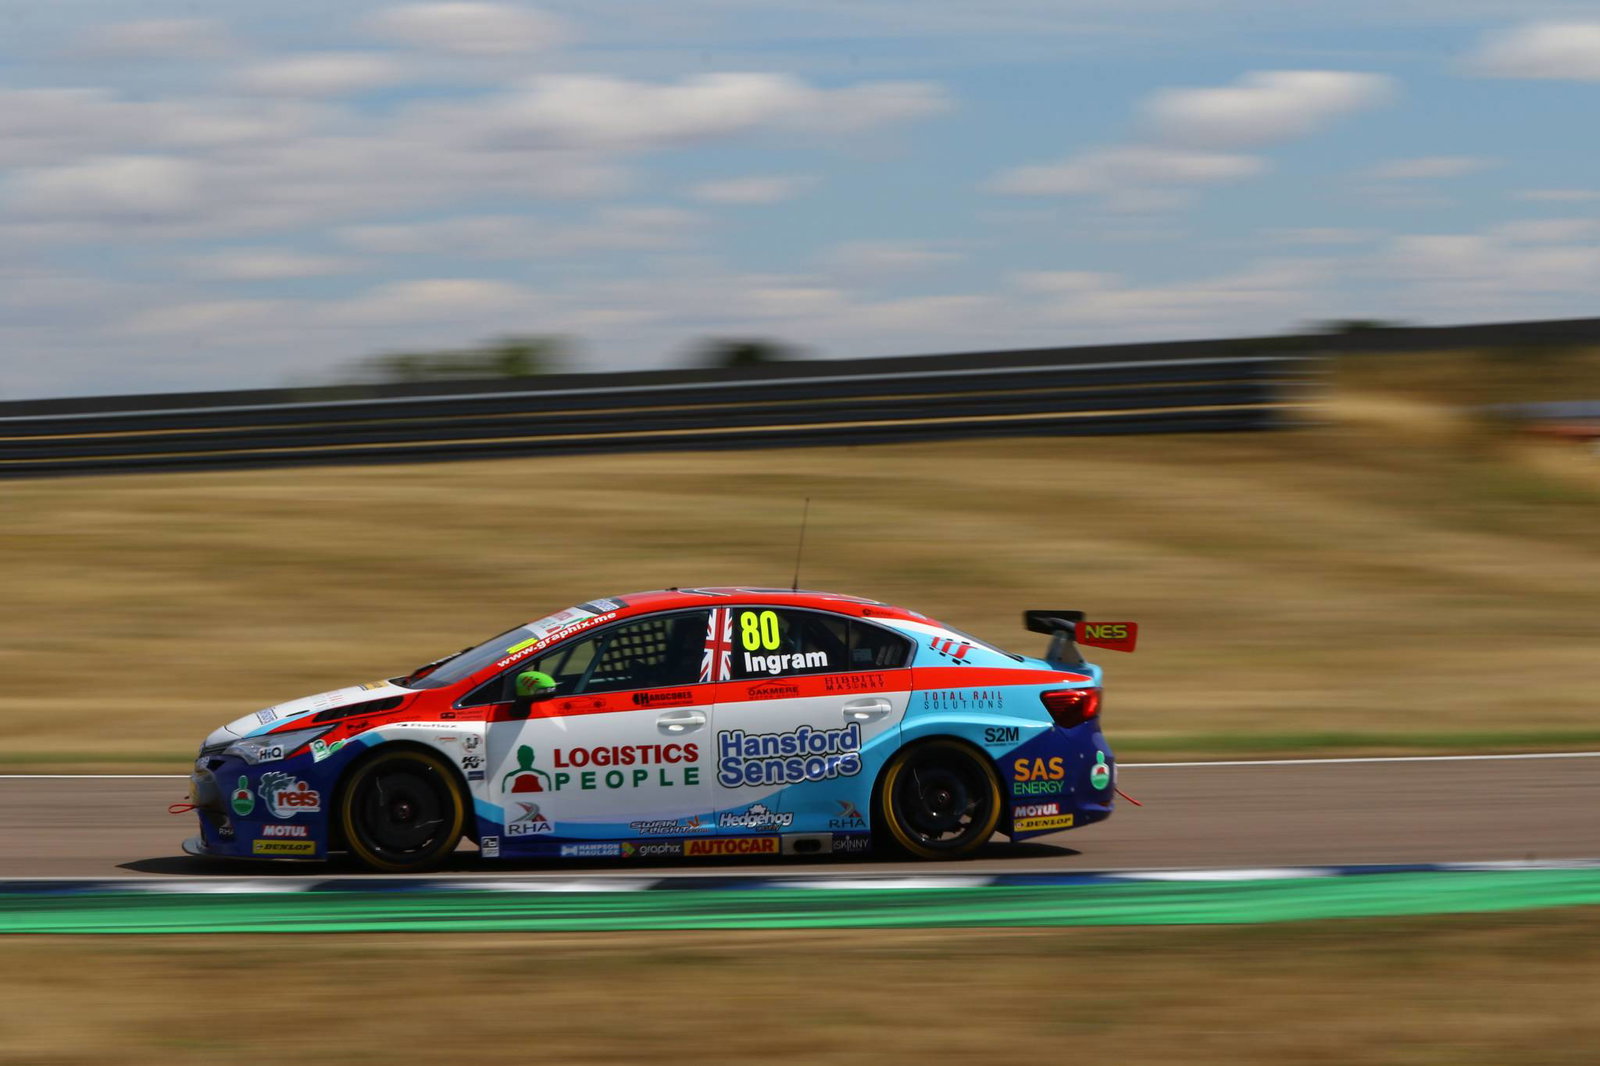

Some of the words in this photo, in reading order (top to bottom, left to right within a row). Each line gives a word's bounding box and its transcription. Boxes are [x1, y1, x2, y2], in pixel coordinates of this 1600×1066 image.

[740, 610, 780, 651] 80
[1085, 624, 1128, 639] NES
[497, 612, 617, 668] www.graphix.me
[743, 650, 828, 675] Ingram
[923, 692, 964, 701] TOTAL
[973, 690, 1004, 700] RAIL
[923, 700, 1004, 710] SOLUTIONS
[720, 724, 858, 758] Hansford
[984, 727, 1019, 743] S2M
[553, 743, 699, 768] LOGISTICS
[720, 753, 860, 785] Sensors
[1014, 756, 1065, 782] SAS
[554, 767, 700, 791] PEOPLE
[276, 781, 320, 808] reis
[1013, 780, 1065, 795] ENERGY
[1014, 803, 1059, 817] MOTUL
[718, 811, 794, 829] Hedgehog
[829, 819, 867, 829] RHA
[1026, 817, 1071, 828] DUNLOP
[262, 825, 307, 837] MOTUL
[508, 823, 552, 836] RHA
[263, 843, 312, 852] DUNLOP
[689, 838, 774, 855] AUTOCAR
